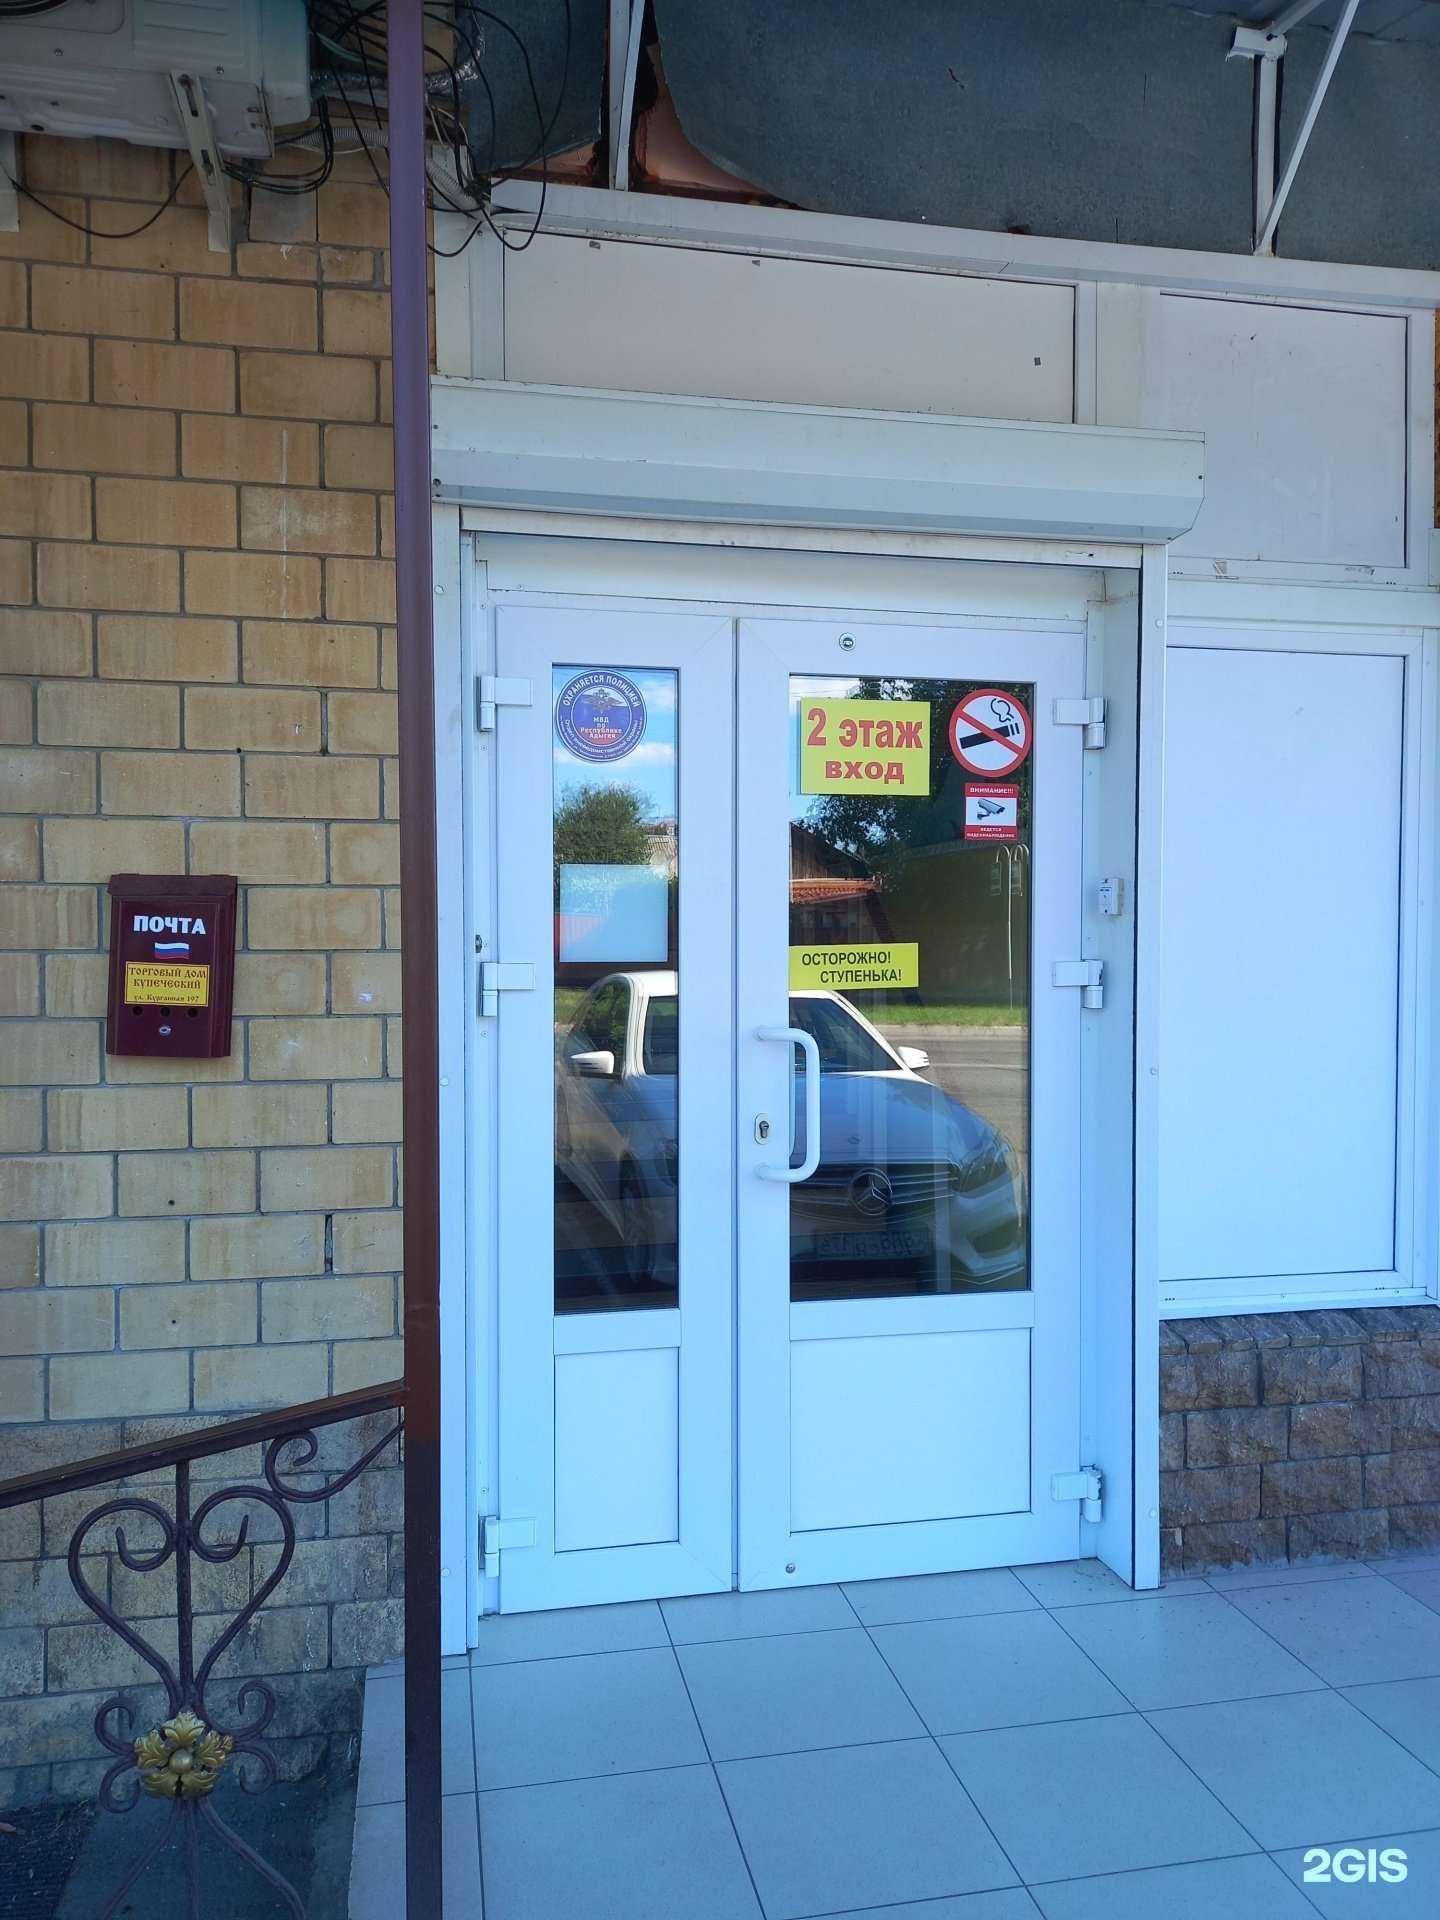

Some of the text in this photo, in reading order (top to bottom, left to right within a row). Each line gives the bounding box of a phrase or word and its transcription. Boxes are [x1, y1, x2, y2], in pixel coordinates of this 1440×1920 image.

[563, 674, 641, 708] ОХРАНЯЕТСЯ ПОЛИЦИЕЙ
[807, 707, 924, 749] 2 этаж
[133, 915, 207, 935] ПОЧТА
[801, 951, 891, 966] ОСТОРОЖНО!
[129, 967, 207, 979] ТОРГОВЫЙ ДОМ
[820, 968, 903, 983] СТУПЕНЬКА!
[133, 978, 201, 989] КУПЕЧЕСКИЙ
